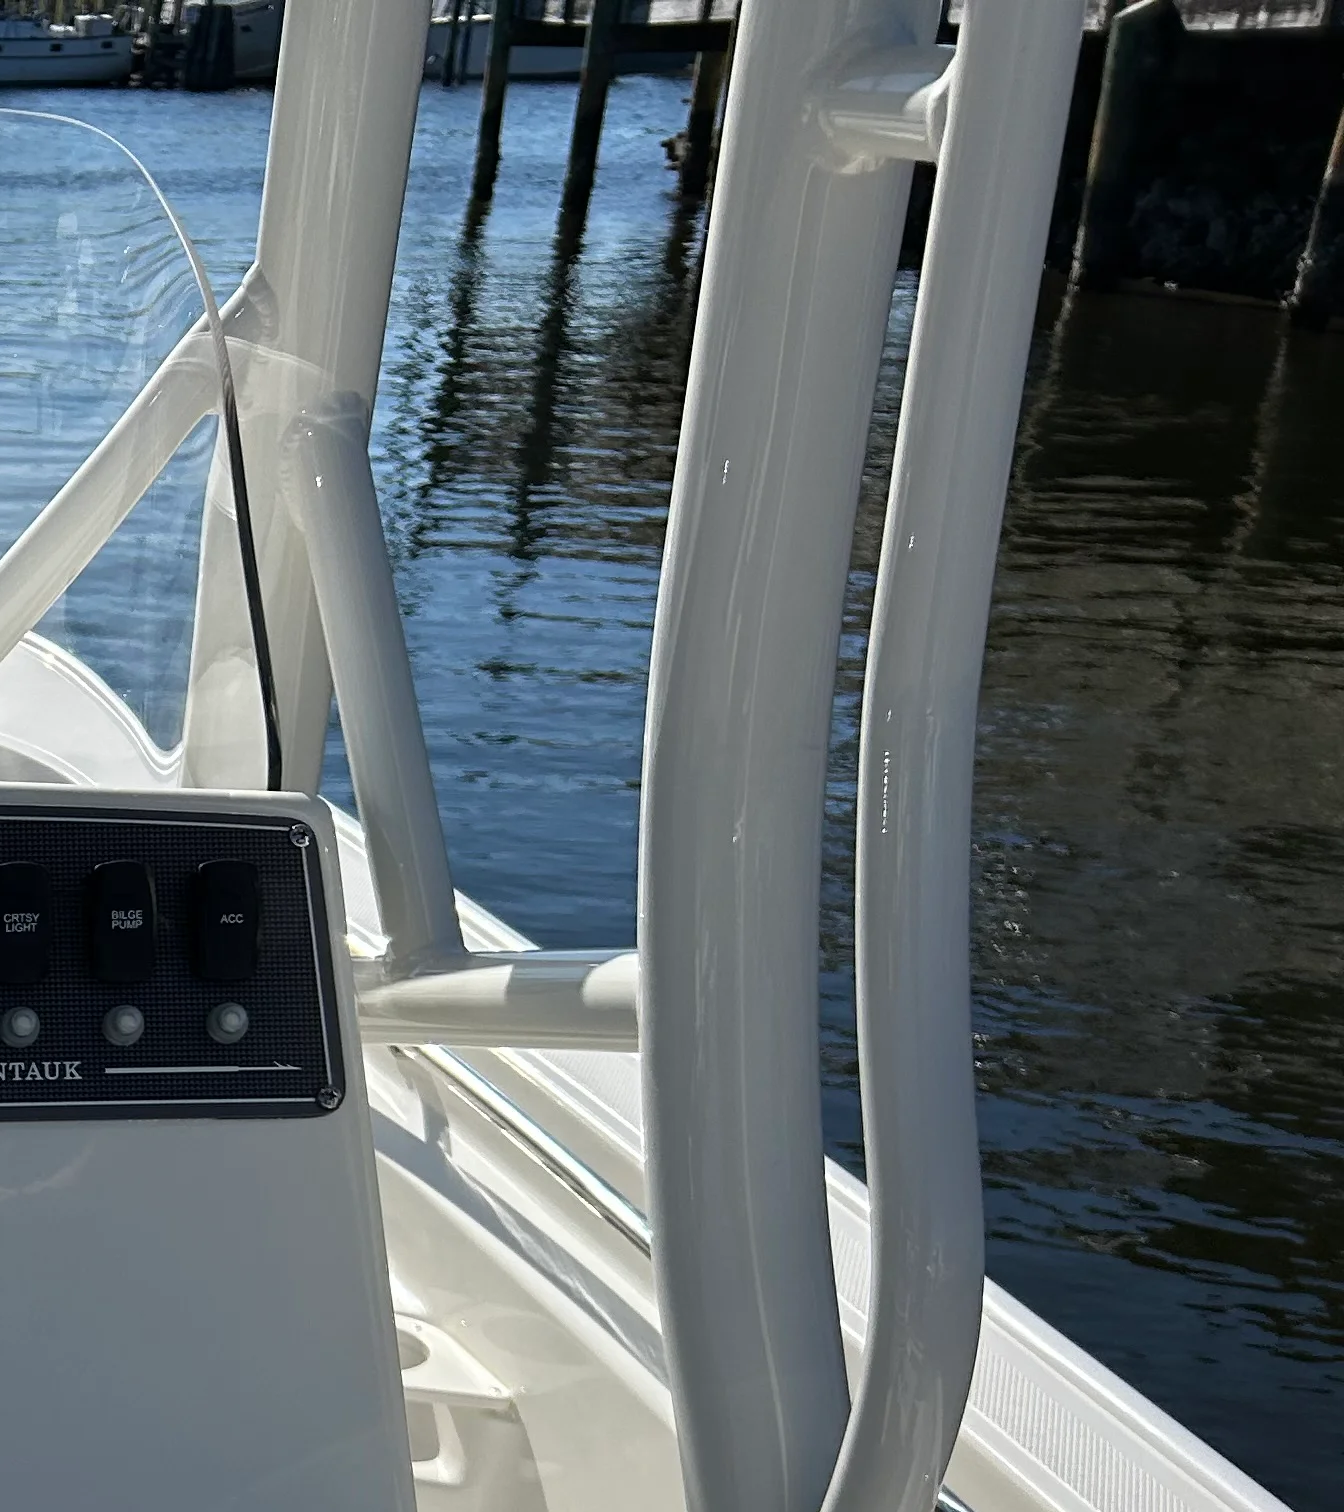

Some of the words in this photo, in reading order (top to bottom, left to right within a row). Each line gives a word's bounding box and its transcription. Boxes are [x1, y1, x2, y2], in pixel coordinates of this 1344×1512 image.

[4, 913, 39, 923] CRTSY
[112, 910, 143, 920] BILGE
[220, 914, 244, 924] ACC
[6, 923, 37, 933] LIGHT
[112, 920, 143, 929] PUMP
